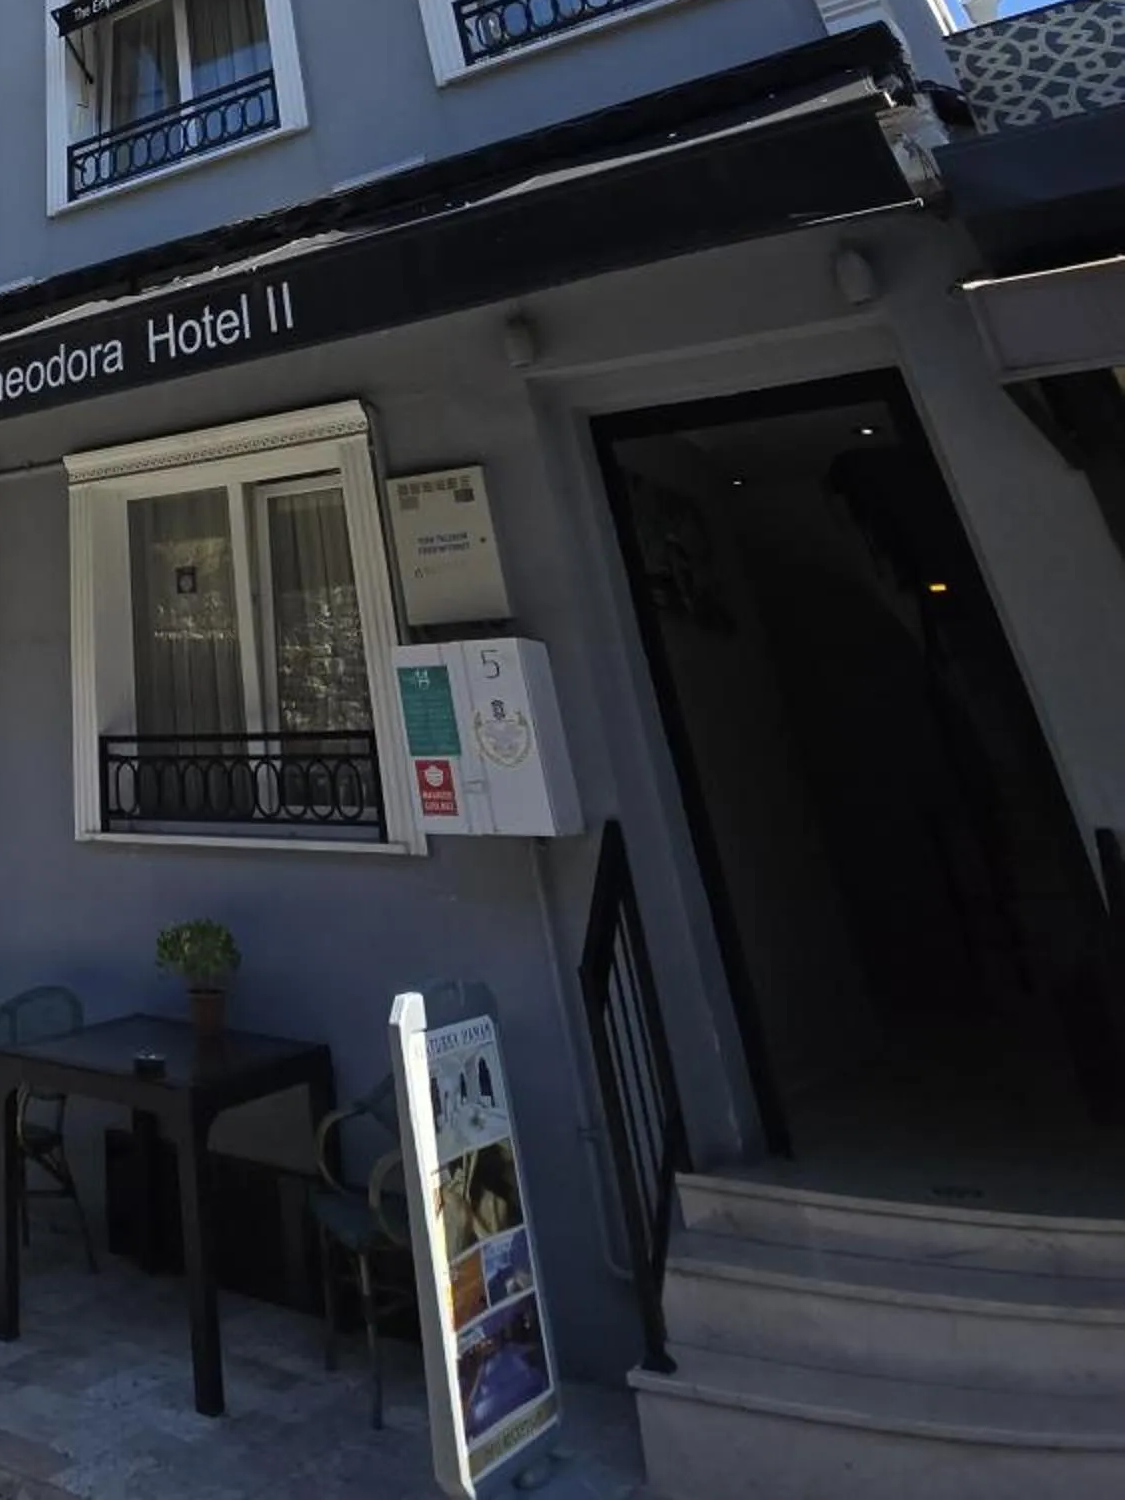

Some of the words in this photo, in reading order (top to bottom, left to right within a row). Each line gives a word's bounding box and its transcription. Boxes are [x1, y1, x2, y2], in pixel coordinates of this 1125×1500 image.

[148, 293, 251, 363] Hotel
[267, 281, 294, 333] II
[480, 648, 501, 679] 5
